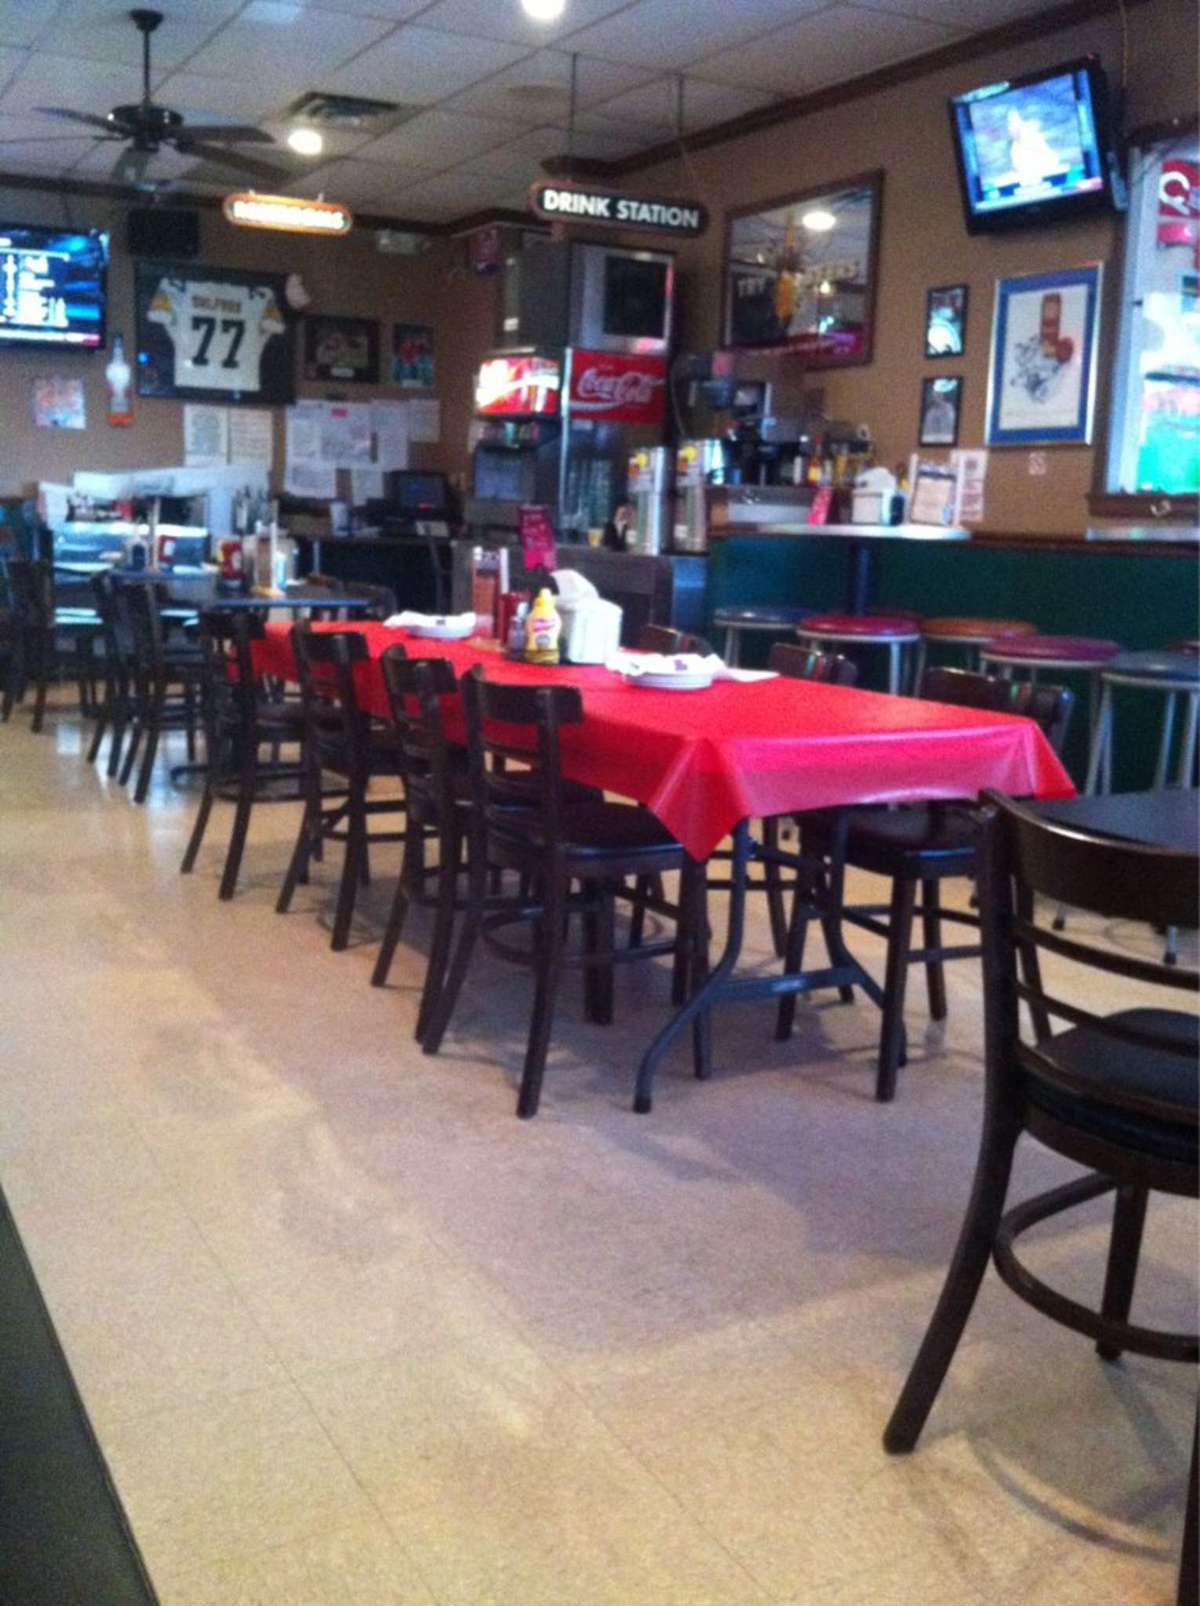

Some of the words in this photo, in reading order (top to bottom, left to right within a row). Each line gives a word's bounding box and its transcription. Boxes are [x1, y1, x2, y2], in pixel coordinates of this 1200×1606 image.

[543, 189, 610, 217] DRINK
[616, 200, 699, 229] STATION
[191, 316, 245, 369] 77
